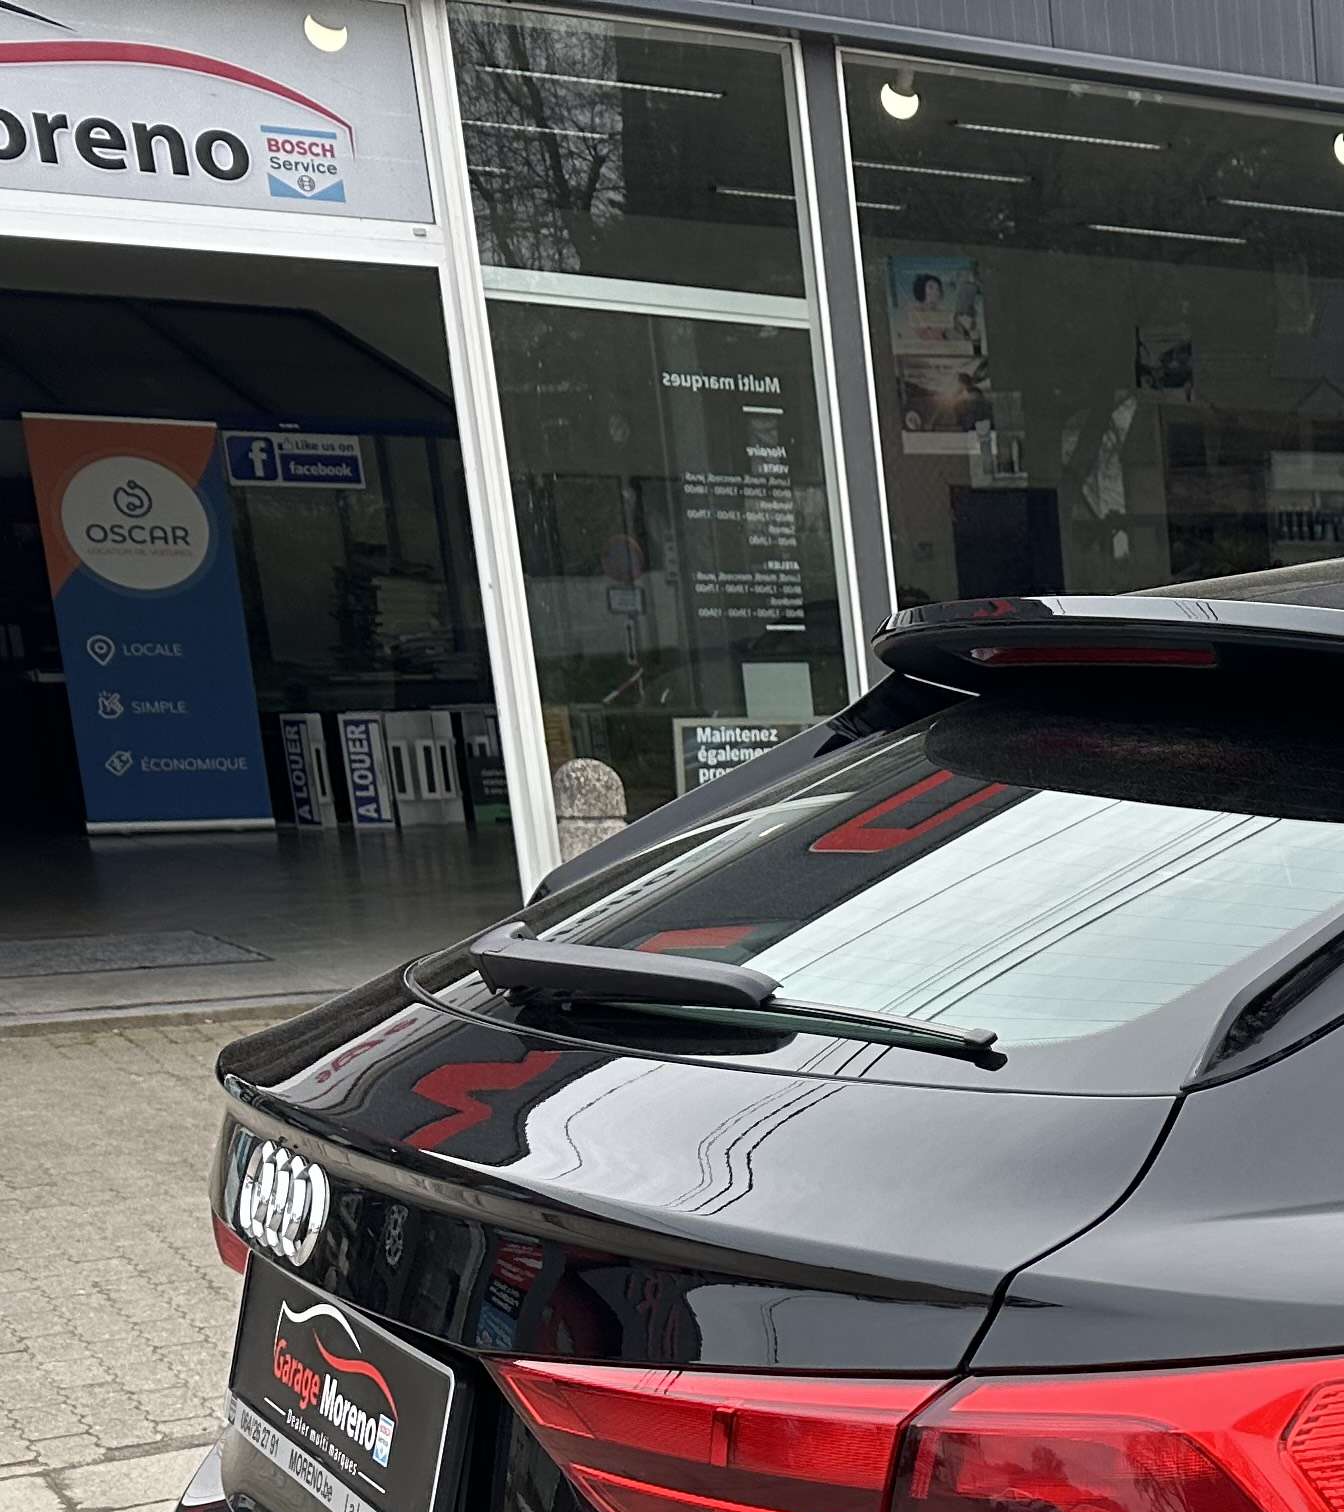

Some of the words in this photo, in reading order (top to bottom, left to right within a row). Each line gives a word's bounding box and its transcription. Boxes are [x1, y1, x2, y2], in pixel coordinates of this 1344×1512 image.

[266, 137, 336, 159] BOSCH
[269, 156, 338, 176] Service
[295, 440, 319, 451] Like
[321, 442, 336, 452] us
[340, 444, 354, 453] on
[289, 460, 352, 477] facebook
[86, 523, 190, 546] OSCAR
[122, 643, 182, 656] LOCALE
[132, 701, 187, 715] SIMPLE
[696, 726, 778, 743] Maintenez
[141, 754, 248, 773] ÉCONOMIQUE
[285, 725, 308, 798] LOUER
[346, 724, 376, 798] LOUER
[698, 745, 772, 766] égaleme
[298, 805, 313, 820] A
[358, 802, 379, 819] A
[273, 1338, 321, 1409] Garage
[319, 1373, 377, 1451] Moreno
[270, 1434, 280, 1457] 91
[286, 1409, 309, 1434] Dealer
[309, 1428, 329, 1453] multi
[329, 1446, 359, 1476] marques
[288, 1449, 333, 1502] MORENO.be
